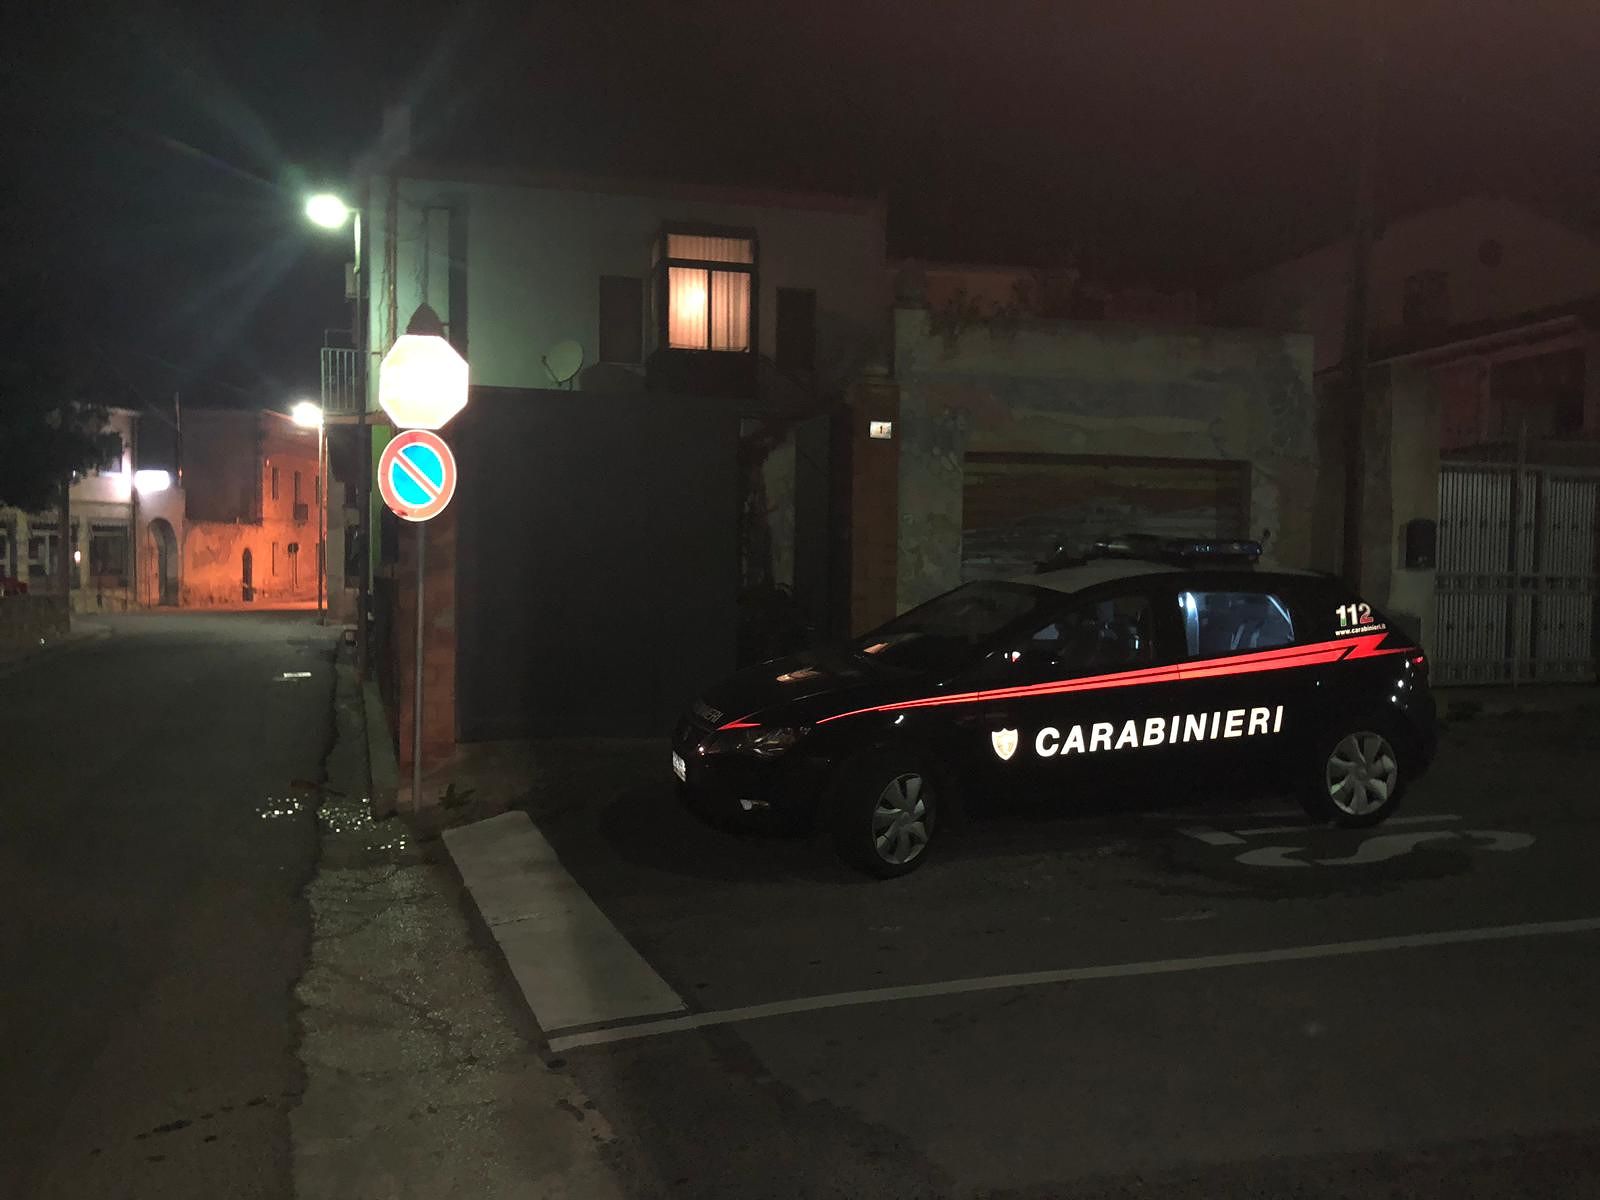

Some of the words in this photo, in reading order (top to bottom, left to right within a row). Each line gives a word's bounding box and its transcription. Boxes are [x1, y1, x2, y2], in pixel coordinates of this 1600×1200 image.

[1335, 602, 1374, 627] 112
[1335, 623, 1386, 636] www.carabinieri.it
[1035, 705, 1284, 757] CARABINIERI
